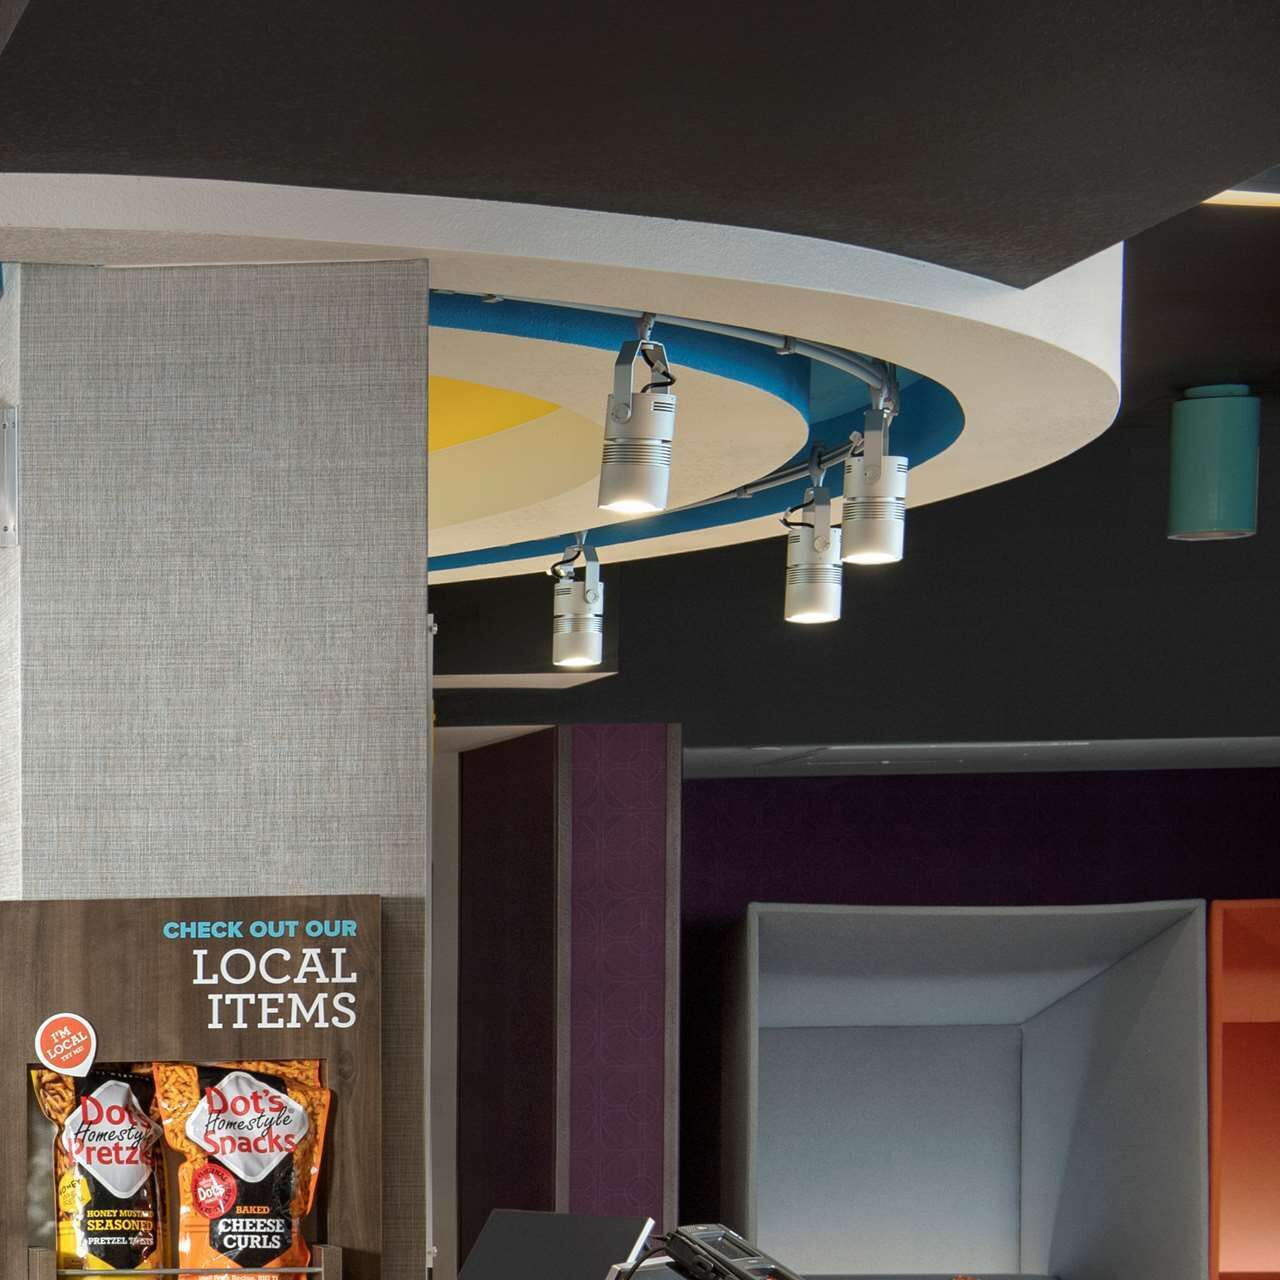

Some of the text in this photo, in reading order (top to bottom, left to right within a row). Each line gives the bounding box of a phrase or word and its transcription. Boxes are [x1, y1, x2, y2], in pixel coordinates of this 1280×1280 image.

[163, 919, 358, 939] CHECK OUT OUR
[192, 947, 358, 985] LOCAL
[207, 992, 357, 1029] ITEMS
[47, 1031, 88, 1059] LOCAL
[205, 1086, 285, 1117] Dot's
[205, 1106, 295, 1136] Homestyle
[202, 1129, 298, 1157] Snacks
[87, 1209, 118, 1218] HONEY
[235, 1205, 270, 1215] BAKED
[87, 1219, 153, 1231] SEASONED
[217, 1217, 285, 1234] CHEESE
[88, 1237, 128, 1245] PRETZEL
[223, 1234, 281, 1250] CURLS
